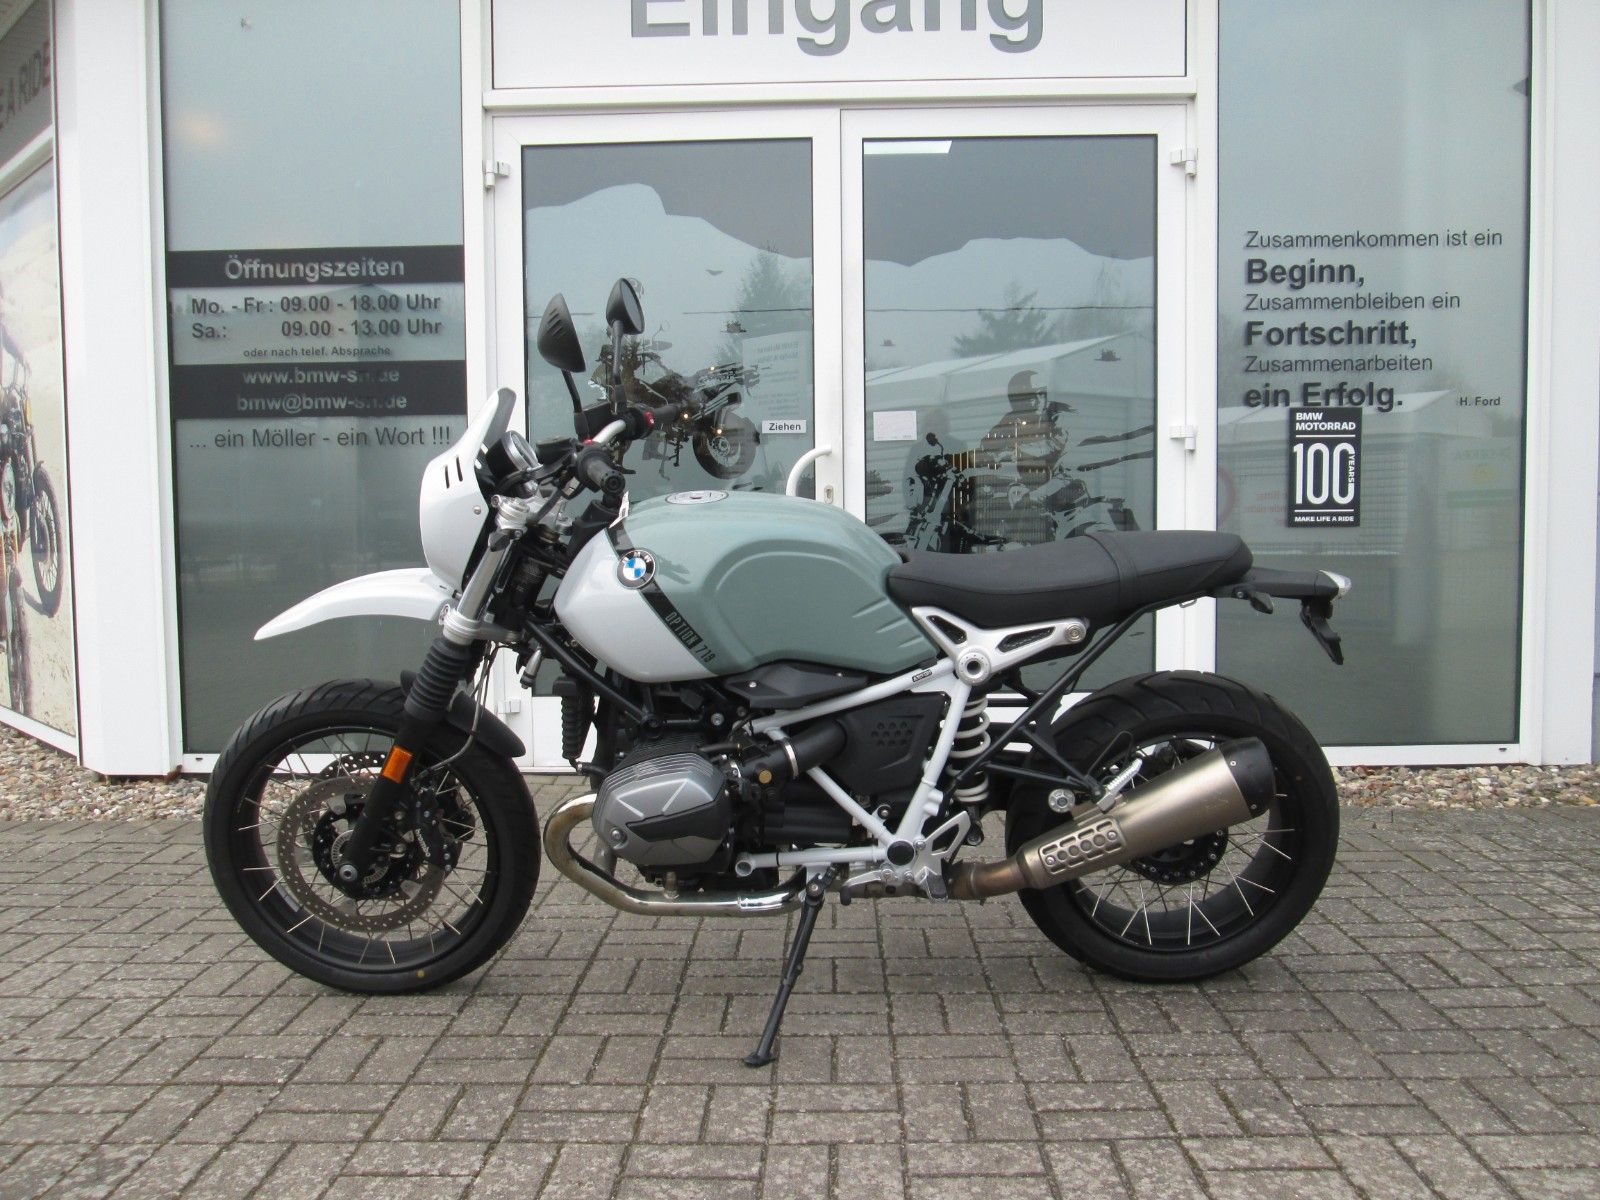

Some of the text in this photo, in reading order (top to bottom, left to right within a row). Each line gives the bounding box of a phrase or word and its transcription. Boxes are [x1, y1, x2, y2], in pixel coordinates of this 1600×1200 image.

[1245, 229, 1503, 248] Zusammenkommen ist ein
[224, 254, 405, 283] Öffnungszeiten
[1246, 258, 1365, 290] Beginn,
[191, 297, 225, 314] Mo.
[280, 295, 330, 313] 09.00
[350, 294, 400, 312] 18.00
[406, 293, 441, 310] Uhr
[1245, 291, 1461, 311] Zusammenbleiben ein
[191, 322, 227, 339] Sa.:
[281, 320, 331, 337] 09.00
[351, 318, 401, 336] 13.00
[407, 318, 442, 335] Uhr
[1245, 320, 1418, 348] Fortschritt,
[243, 346, 391, 359] oder nach telef. Absprache
[1244, 355, 1433, 373] Zusammenarbeiten
[1244, 382, 1404, 413] ein Erfolg.
[1459, 396, 1501, 406] H. Ford
[769, 422, 801, 431] Ziehen
[1295, 422, 1356, 431] MOTORRAD
[1296, 412, 1323, 421] BMW
[214, 429, 244, 448] ein
[252, 428, 317, 448] Möller
[337, 427, 369, 446] ein
[376, 426, 425, 446] Wort
[432, 425, 451, 445] !!!
[1293, 442, 1356, 505] 100
[665, 612, 700, 647] OPTION
